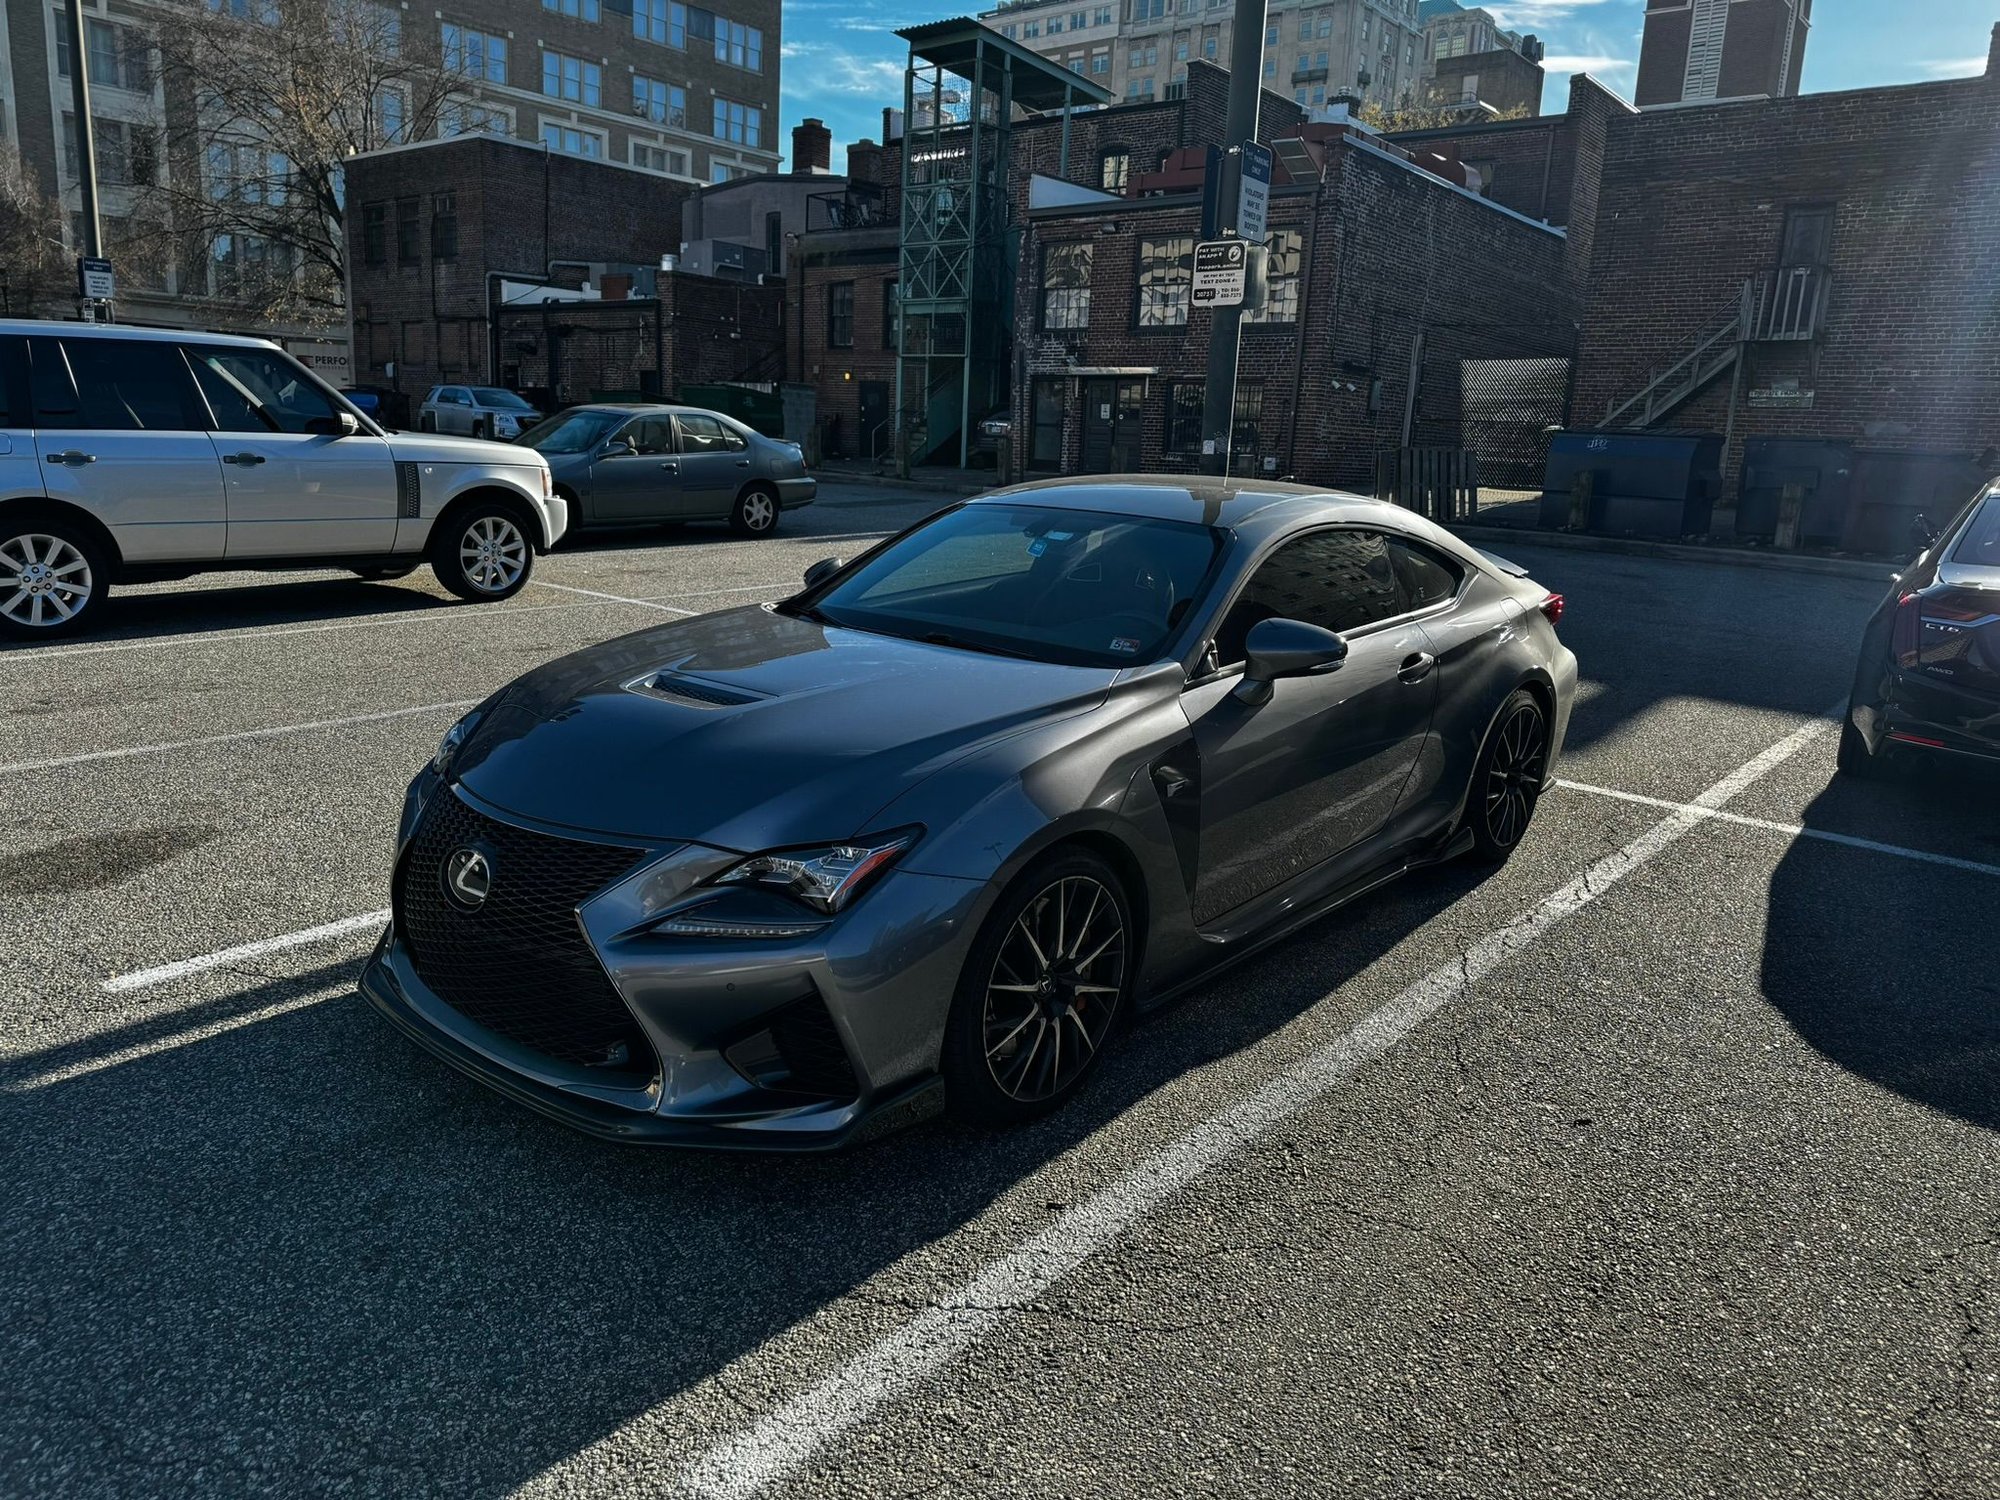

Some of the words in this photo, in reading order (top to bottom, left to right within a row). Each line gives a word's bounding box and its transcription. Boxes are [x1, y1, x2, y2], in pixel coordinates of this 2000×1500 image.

[1245, 188, 1264, 200] VIOLATORS
[315, 356, 347, 366] PERFO
[1927, 666, 1954, 675] AWD
